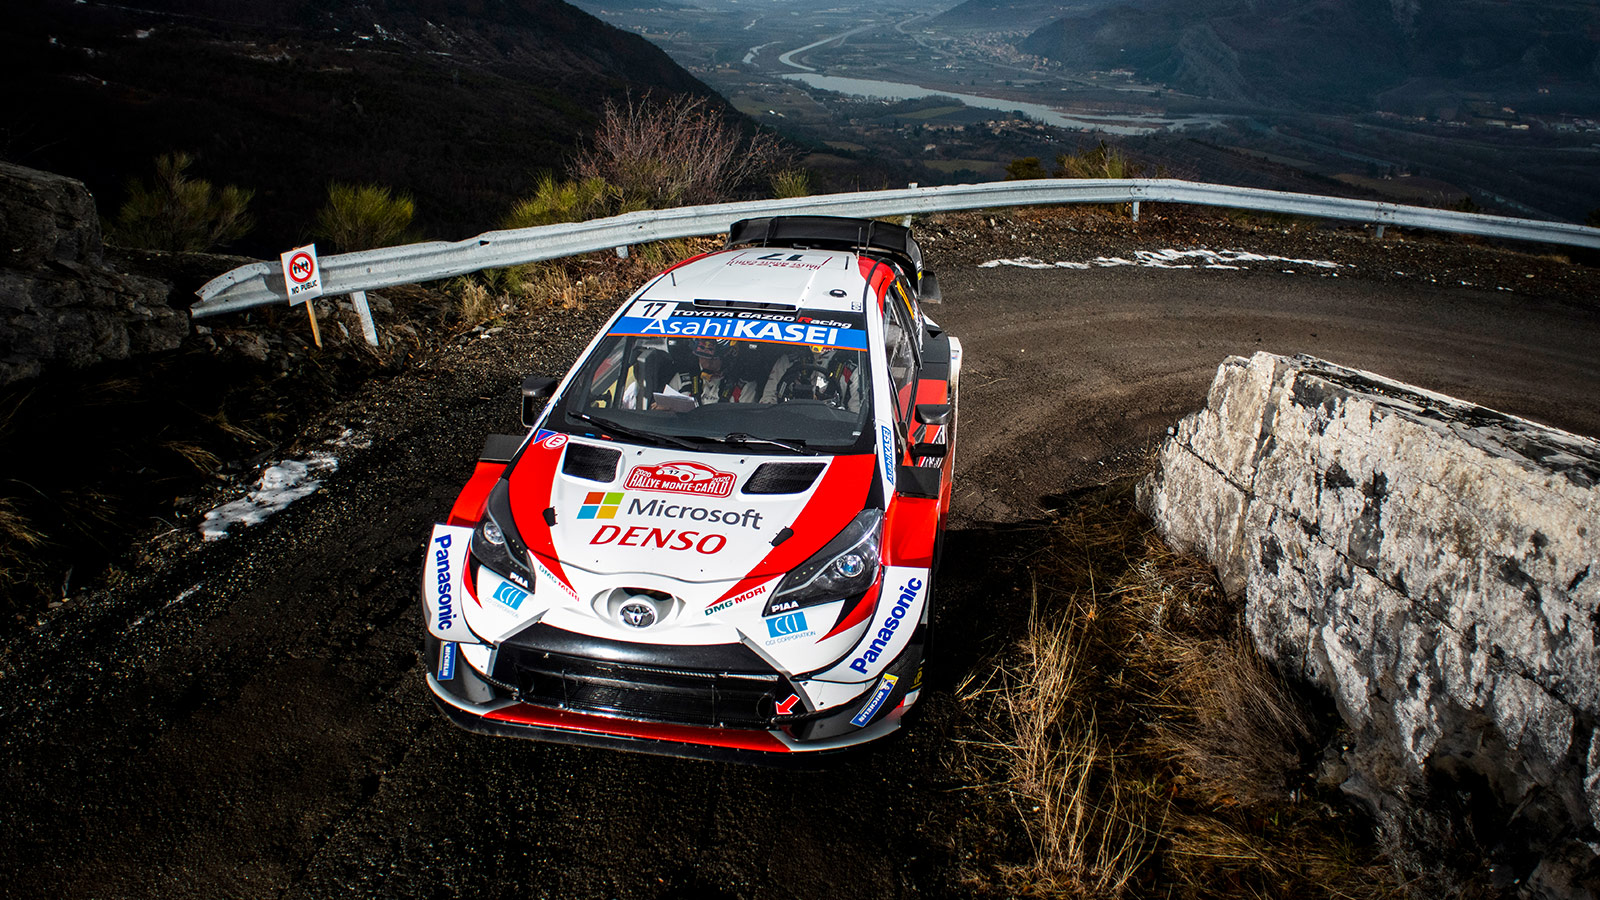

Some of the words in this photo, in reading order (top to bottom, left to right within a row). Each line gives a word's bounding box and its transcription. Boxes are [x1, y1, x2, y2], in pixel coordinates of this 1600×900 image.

[291, 286, 300, 295] NO
[300, 280, 318, 291] PUBLIC
[641, 303, 662, 317] 17
[673, 309, 734, 318] TOYOTA
[737, 312, 795, 322] GAZOO
[797, 316, 852, 329] Racing
[549, 437, 563, 446] E
[635, 468, 652, 478] 2020
[629, 473, 661, 488] RALLYE
[662, 480, 729, 495] MONTE-CARLO
[627, 498, 763, 530] Microsoft
[589, 524, 727, 555] DENSO
[435, 533, 457, 631] Panasonic
[509, 571, 529, 588] PIAA
[538, 564, 557, 584] DMG
[704, 601, 734, 616] DMG
[734, 586, 767, 604] MORI
[771, 600, 800, 613] PIAA
[849, 577, 923, 675] Panasonic
[442, 646, 452, 677] MICHELIN
[858, 692, 885, 723] MICHELIN
